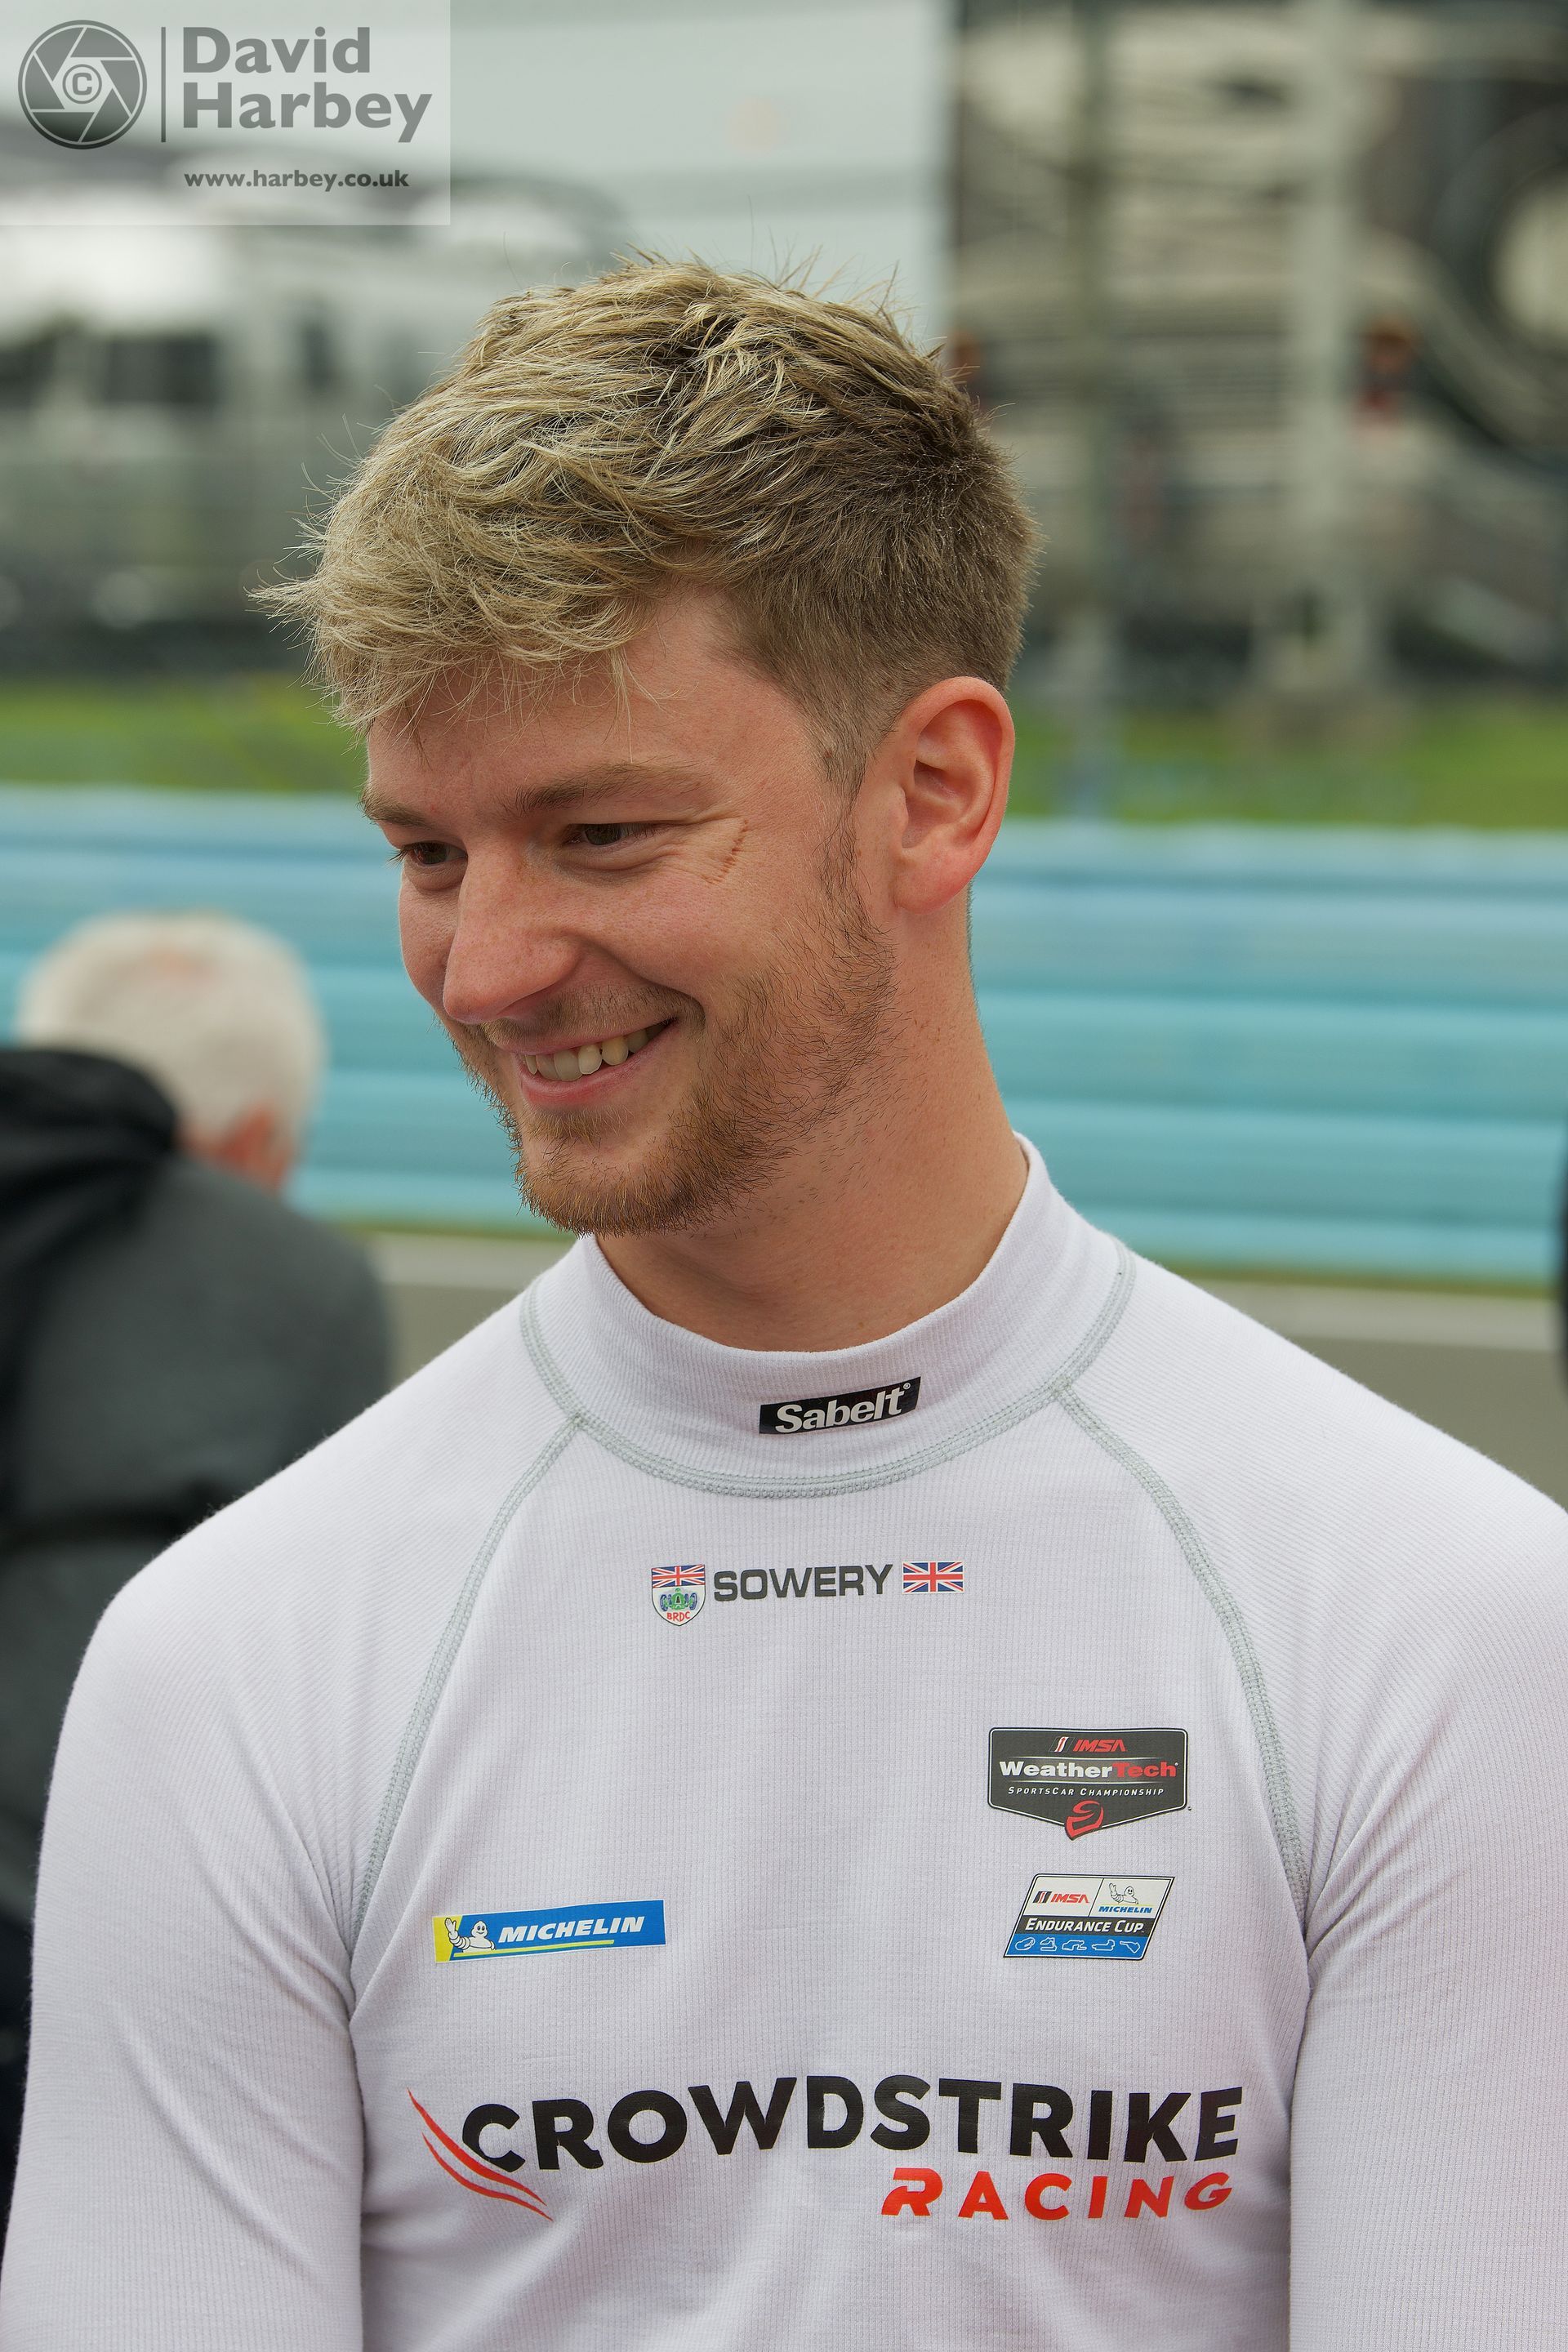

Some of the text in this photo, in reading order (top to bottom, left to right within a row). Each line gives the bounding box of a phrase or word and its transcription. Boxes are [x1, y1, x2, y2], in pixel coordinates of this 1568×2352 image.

[713, 1564, 893, 1602] SOWERY
[666, 1610, 691, 1622] BRDC
[1072, 1739, 1126, 1753] IMSA
[1050, 1893, 1090, 1904] IMSA
[1098, 1905, 1153, 1913] MICHELIN
[497, 1916, 645, 1944] MICHELIN
[1025, 1918, 1112, 1932] ENDURANCE
[462, 2074, 1244, 2172] CROWDSTRIKE
[881, 2167, 1233, 2221] RACING
